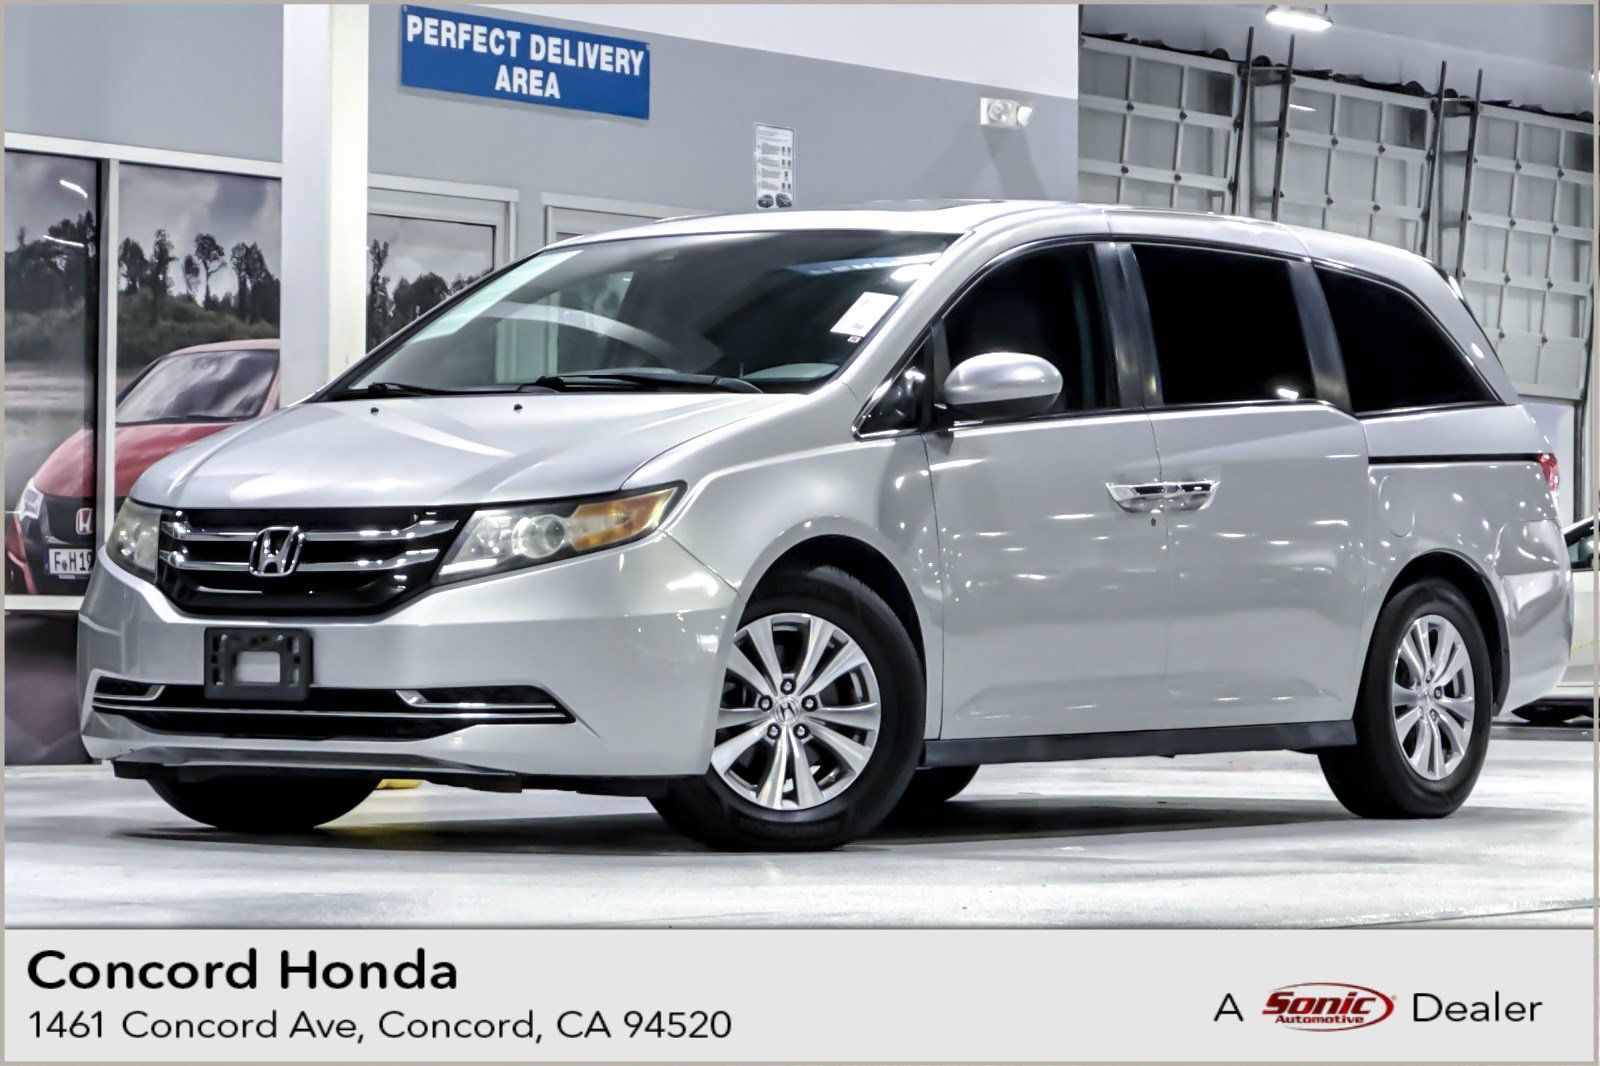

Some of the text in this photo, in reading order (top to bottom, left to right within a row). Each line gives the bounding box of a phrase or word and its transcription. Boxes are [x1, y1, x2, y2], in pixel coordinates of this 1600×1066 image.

[406, 15, 645, 76] PERFECT DELIVERY
[494, 65, 561, 99] AREA
